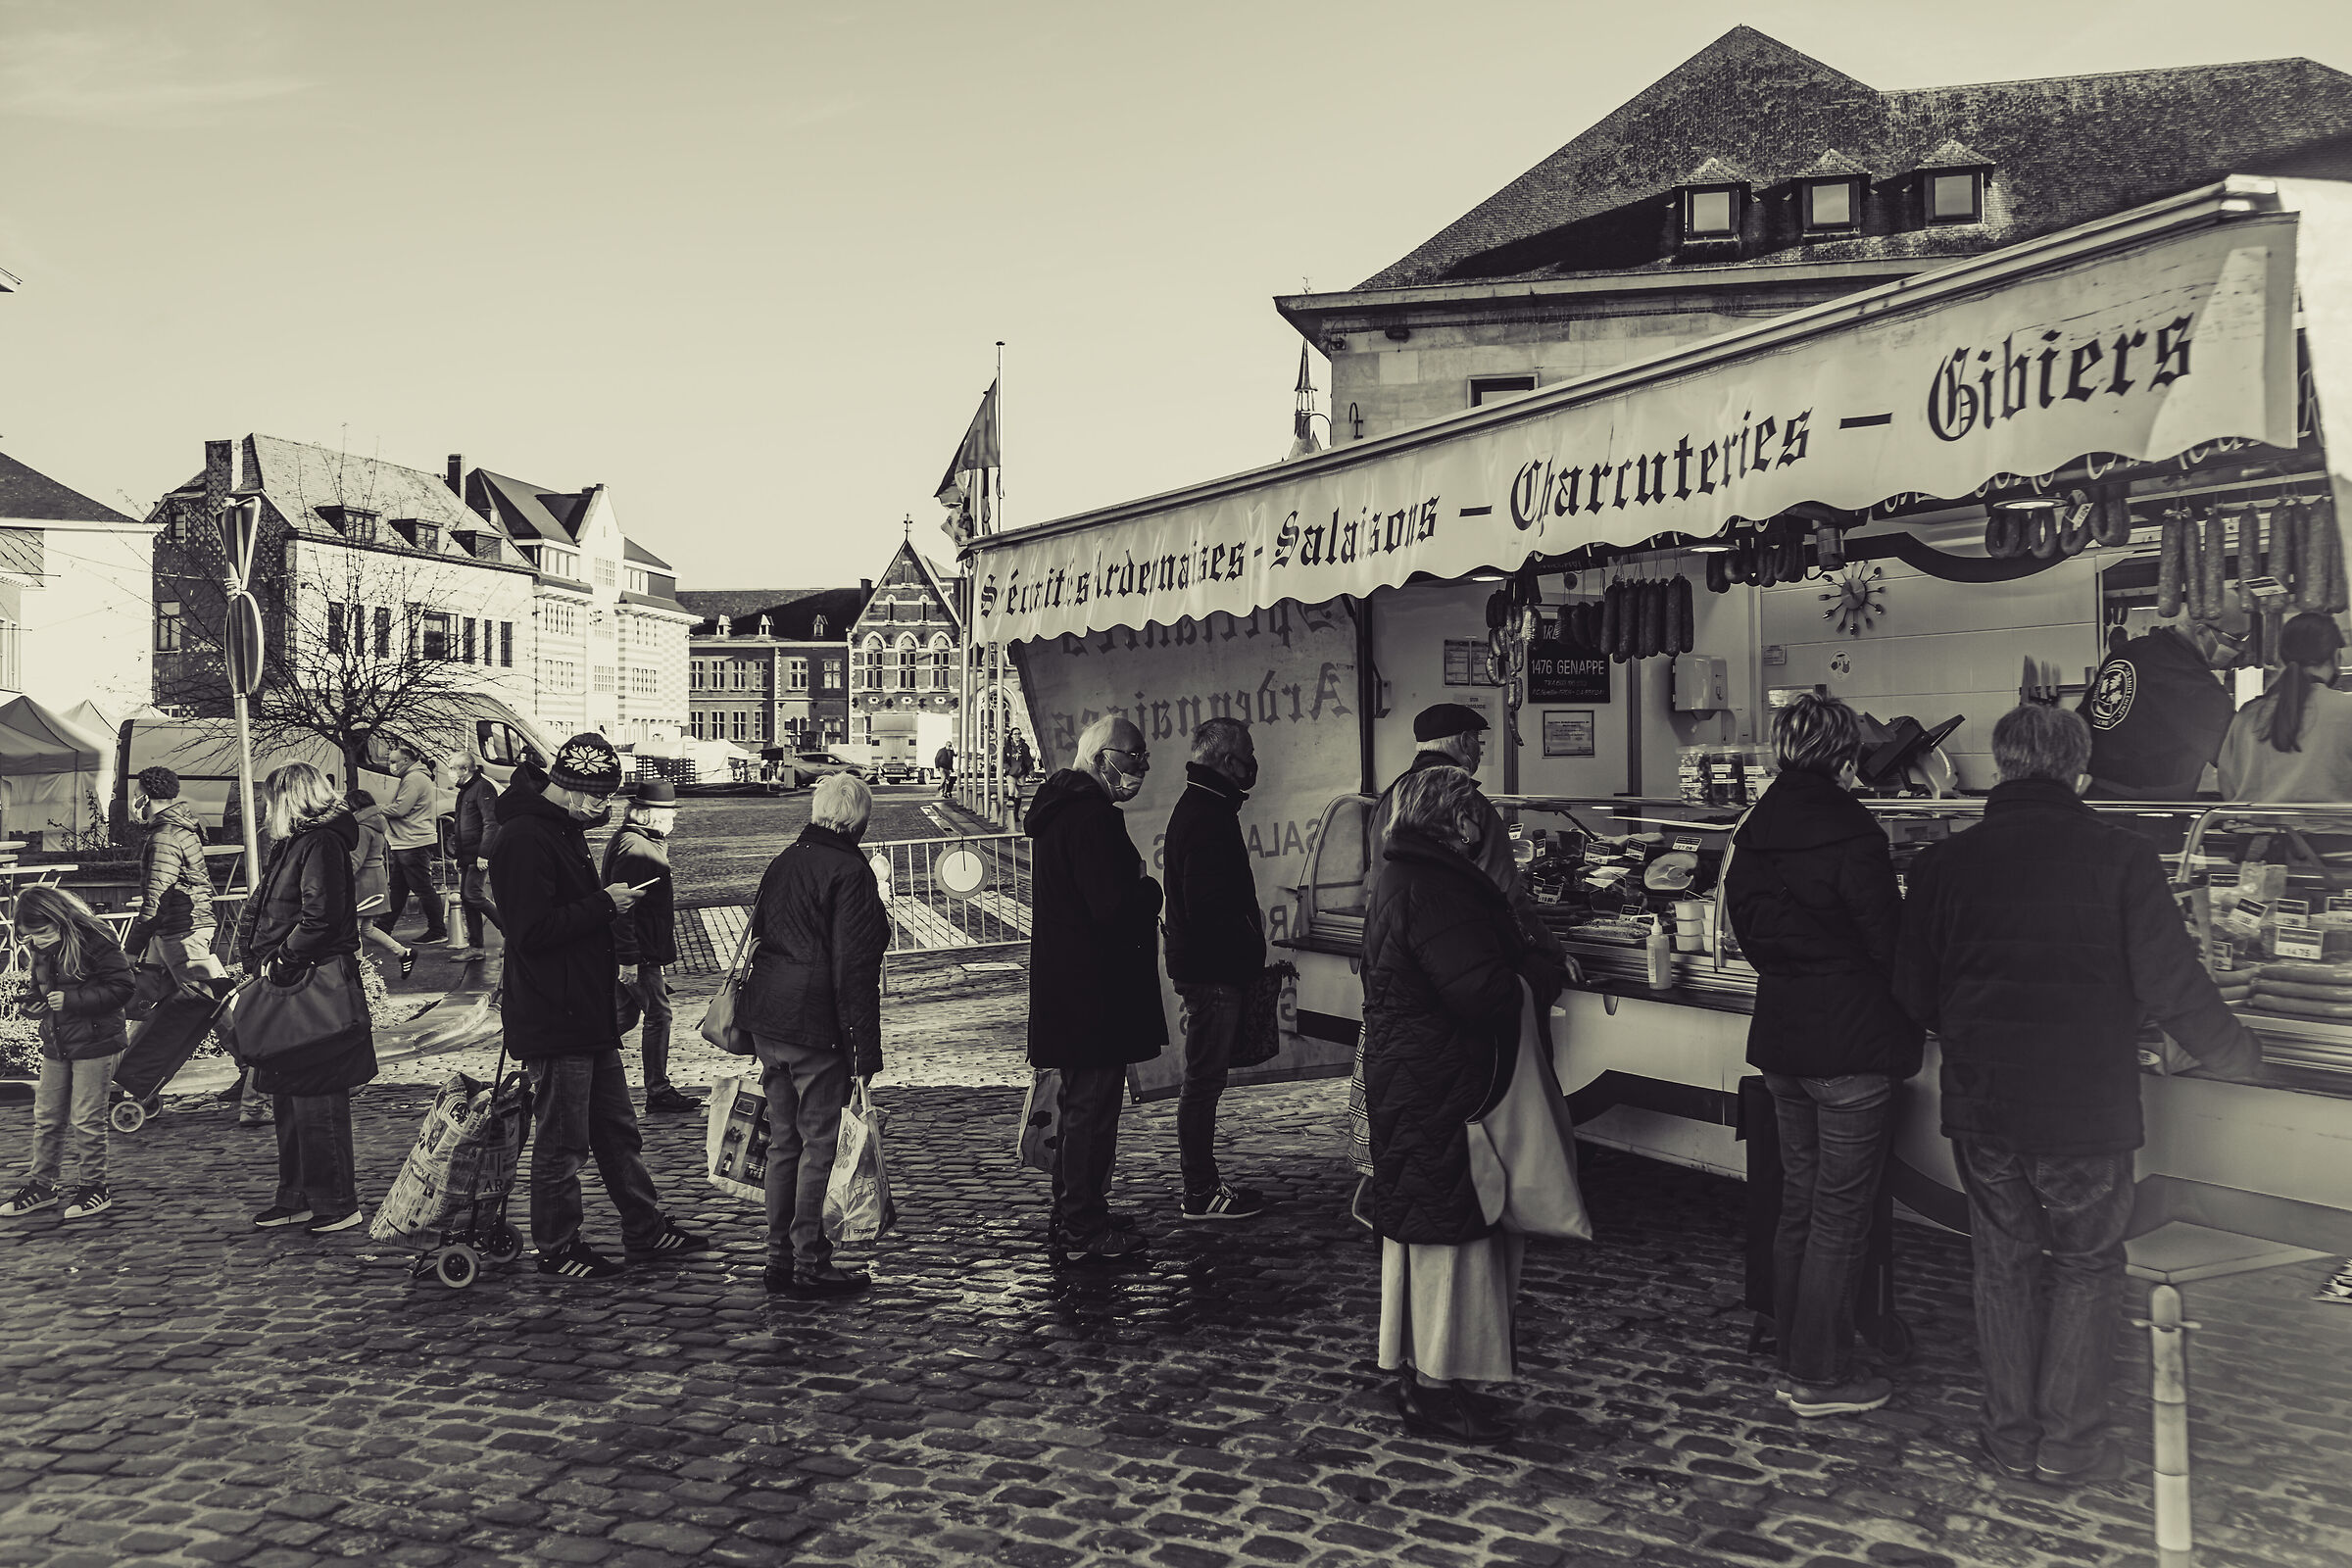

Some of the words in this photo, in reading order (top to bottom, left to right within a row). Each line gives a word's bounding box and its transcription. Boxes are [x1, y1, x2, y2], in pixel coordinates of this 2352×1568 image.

[1269, 495, 1440, 570] Salaisons
[1510, 407, 1813, 538] Charcuteries
[1928, 312, 2194, 442] Gibiers
[1531, 660, 1552, 675] 1476
[1557, 660, 1604, 675] GENAPPE
